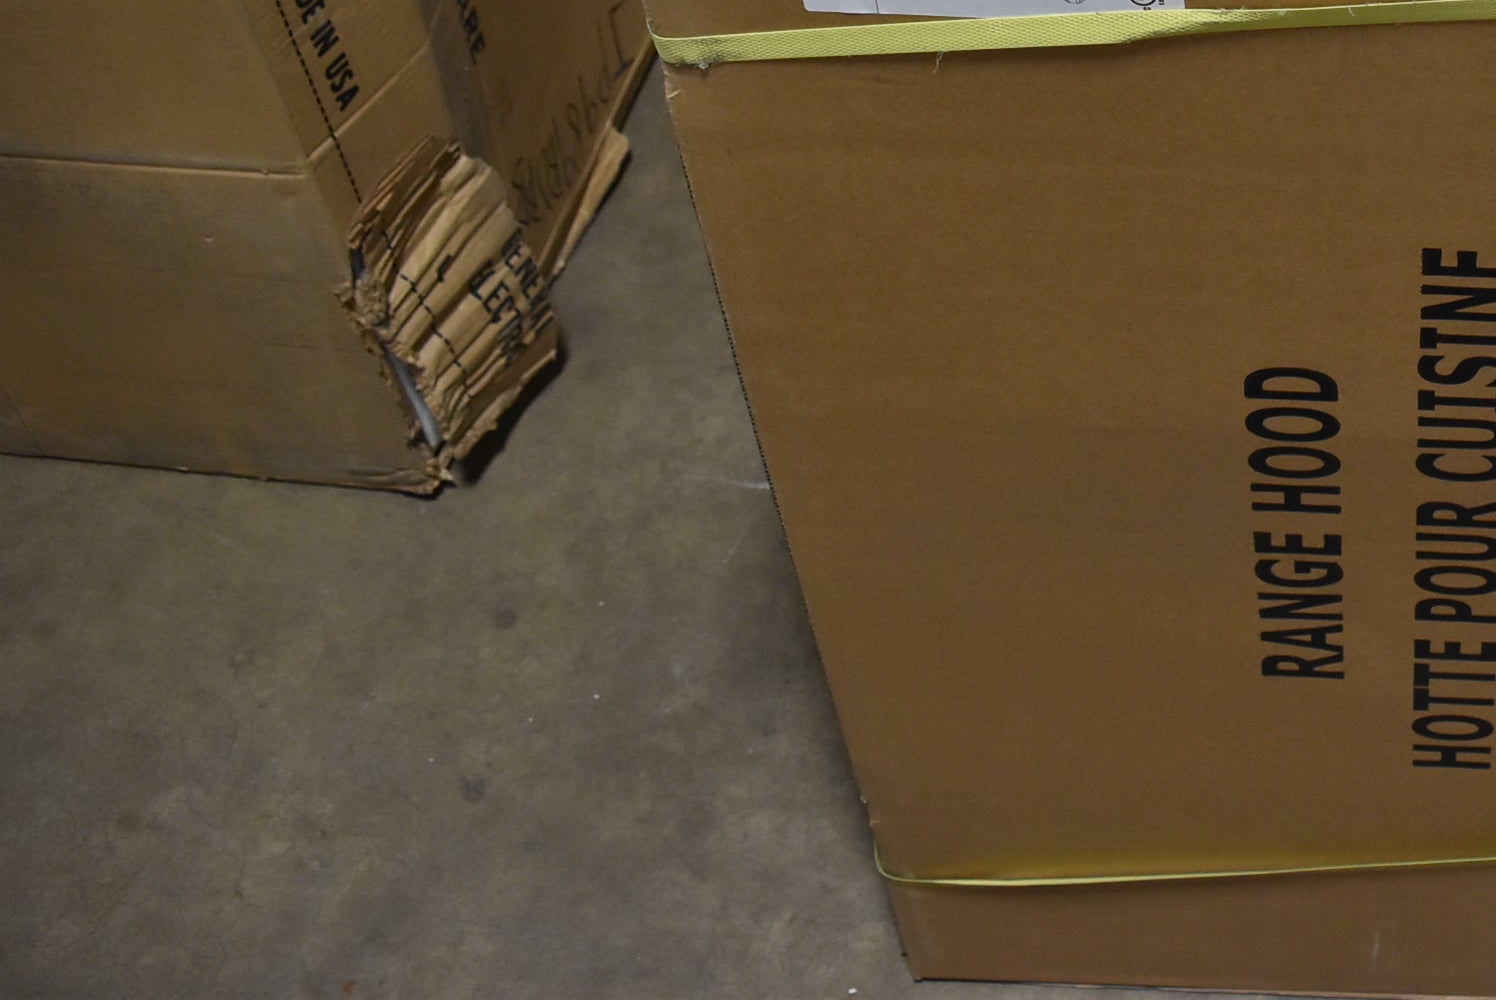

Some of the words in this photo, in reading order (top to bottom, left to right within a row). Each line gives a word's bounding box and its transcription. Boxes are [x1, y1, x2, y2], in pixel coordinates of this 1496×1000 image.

[309, 18, 340, 60] IN
[323, 52, 361, 112] USA
[1244, 366, 1341, 514] HOOD
[1253, 531, 1345, 679] RANGE
